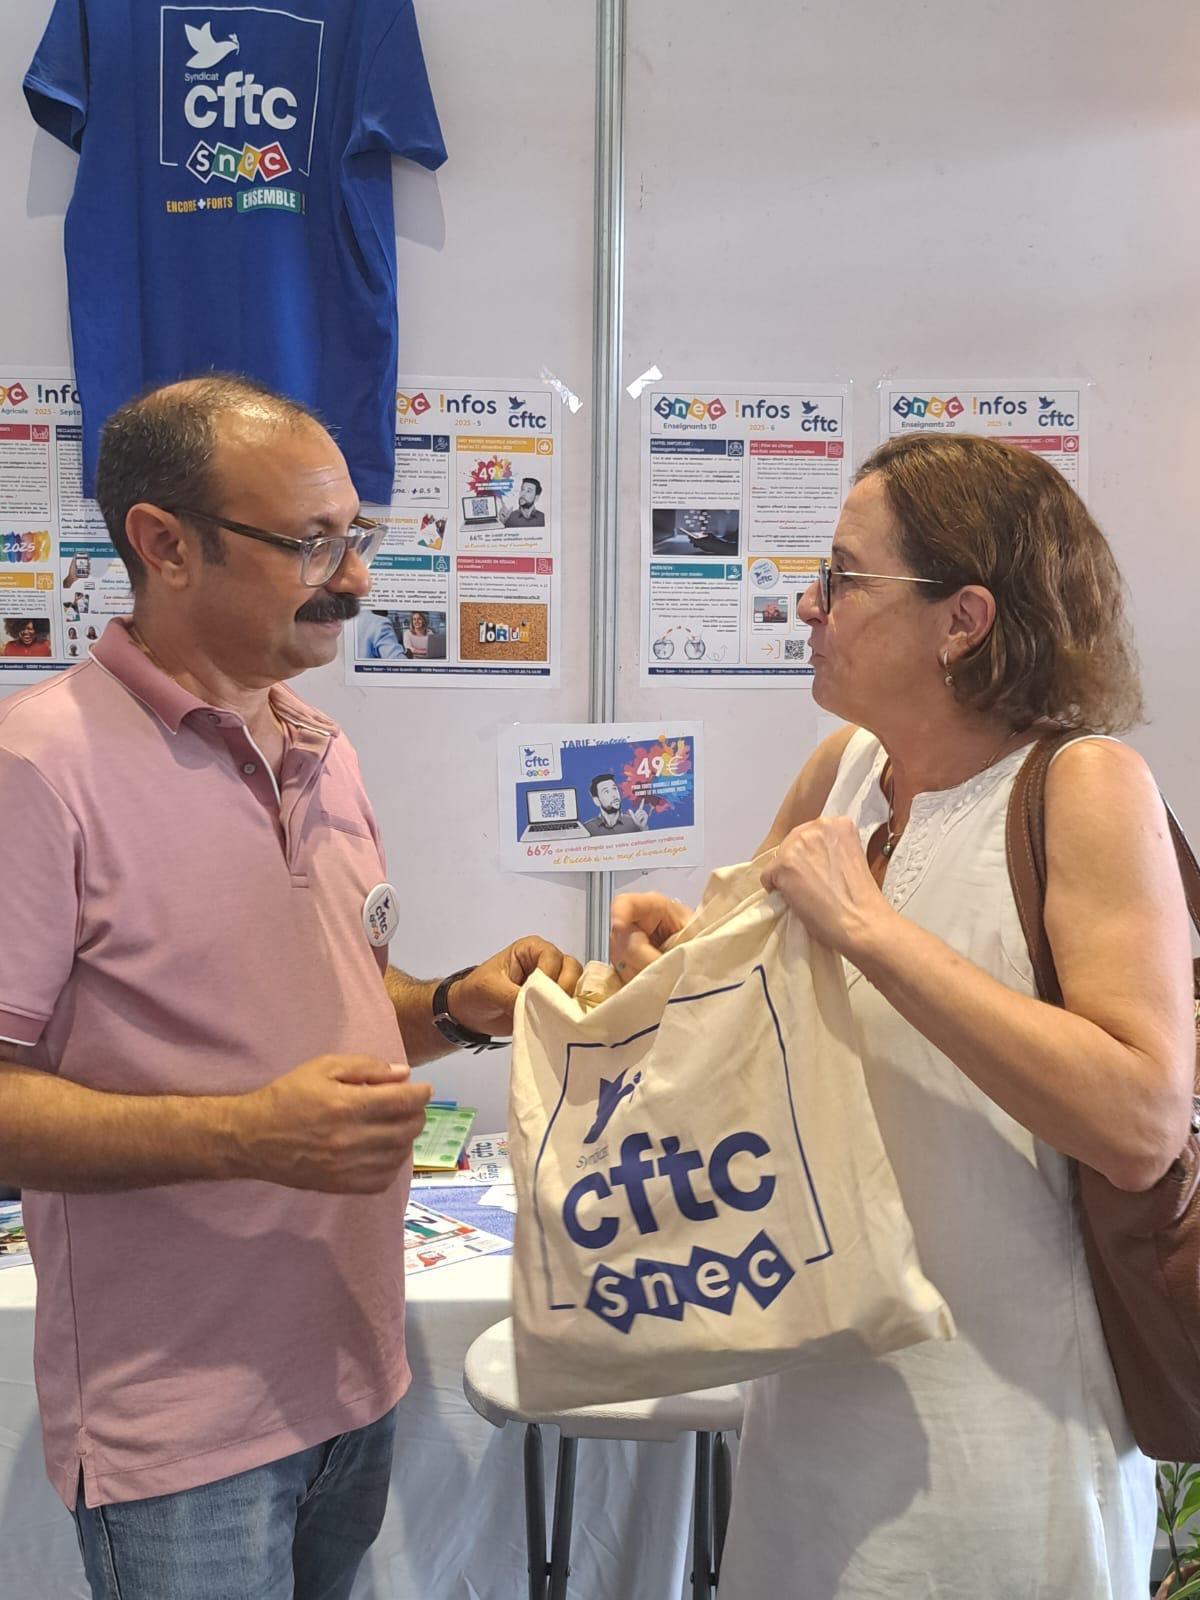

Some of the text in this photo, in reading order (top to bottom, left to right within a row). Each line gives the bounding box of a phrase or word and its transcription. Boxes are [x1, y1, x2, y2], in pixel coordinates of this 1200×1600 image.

[184, 72, 219, 83] Syndicat
[184, 71, 298, 130] cftc
[193, 146, 284, 174] snec
[166, 200, 197, 213] ENCORE
[207, 197, 233, 209] FORTS
[243, 189, 296, 208] ENSEMBLE
[37, 384, 81, 404] !nfo
[60, 408, 81, 416] Septe
[658, 399, 719, 417] snec
[896, 399, 961, 415] snec
[508, 411, 547, 429] cftc
[801, 415, 838, 432] cftc
[901, 421, 944, 429] Enseignants
[1038, 410, 1075, 427] cftc
[4, 542, 36, 552] 2025
[525, 756, 549, 768] cftc
[636, 756, 685, 778] 49€
[527, 844, 553, 857] 66%
[562, 1131, 776, 1249] cftc
[593, 1246, 784, 1320] snec
